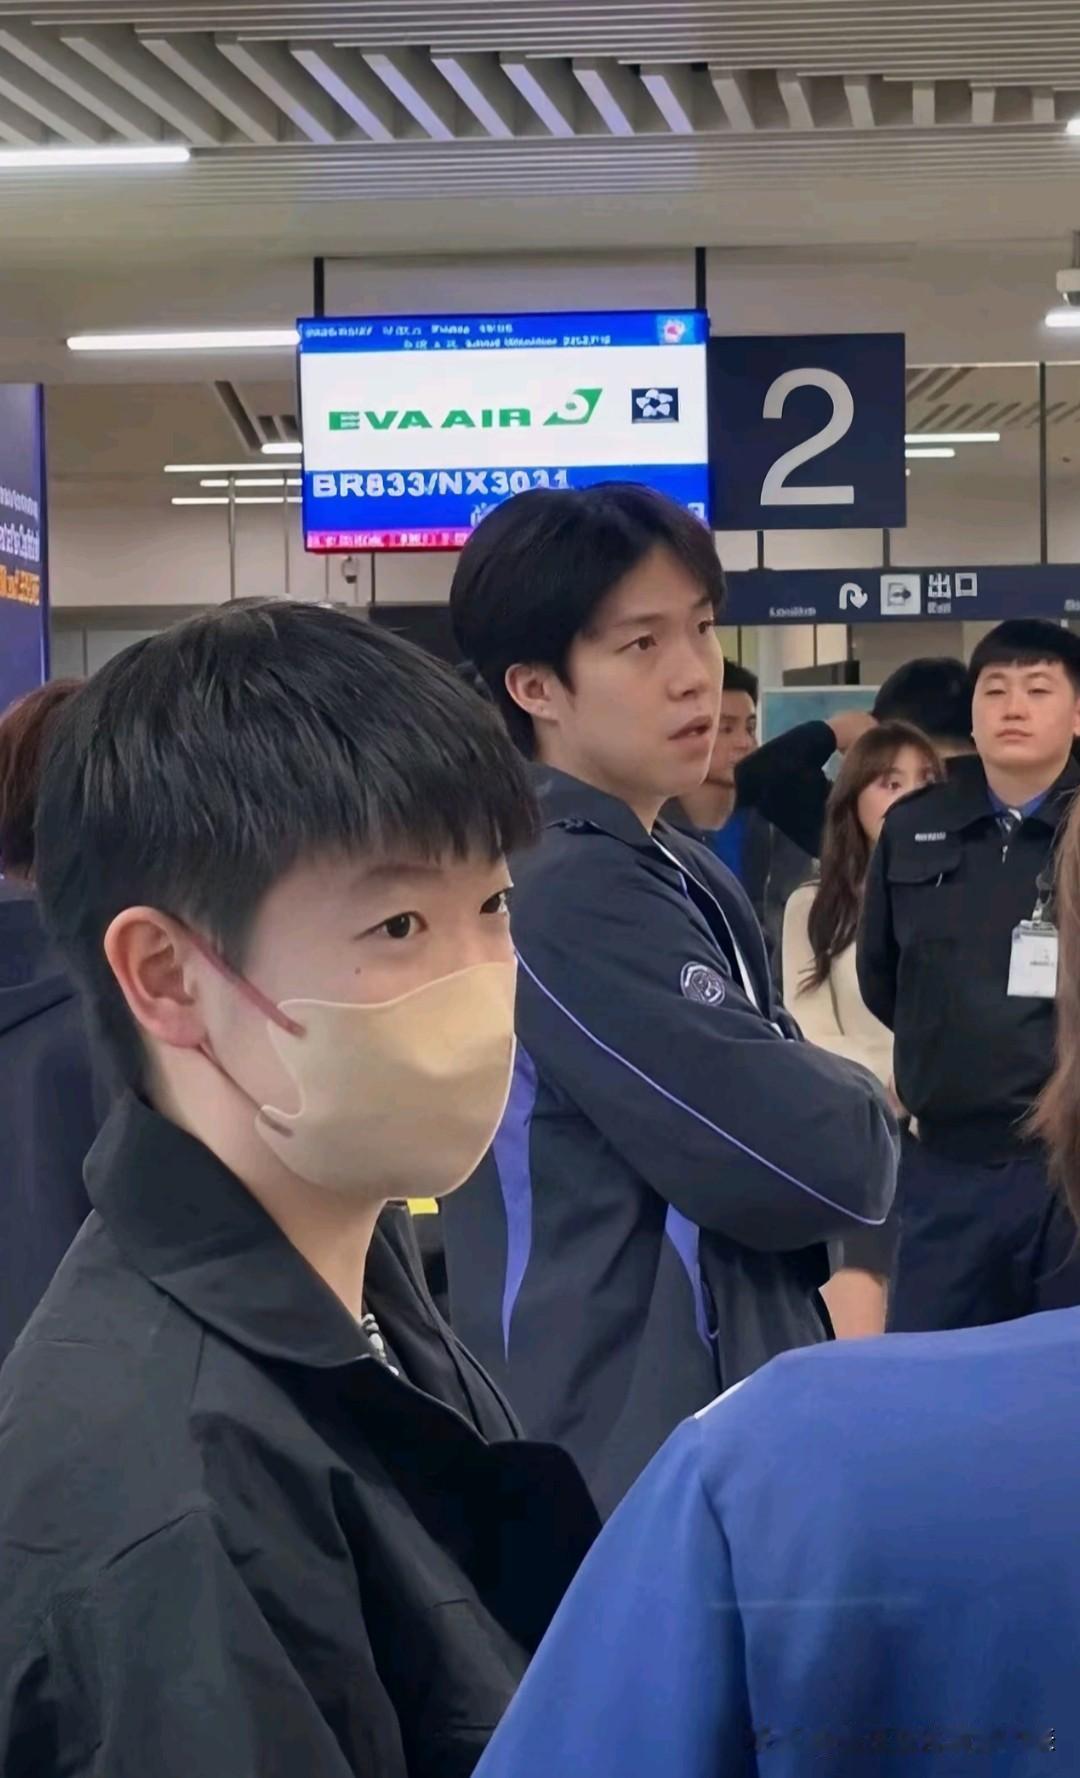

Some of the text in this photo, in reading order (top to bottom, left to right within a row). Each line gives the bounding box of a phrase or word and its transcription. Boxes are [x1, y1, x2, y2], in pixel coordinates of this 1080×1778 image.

[328, 408, 531, 431] EVA AIR
[760, 367, 855, 506] 2
[927, 572, 978, 599] 出口
